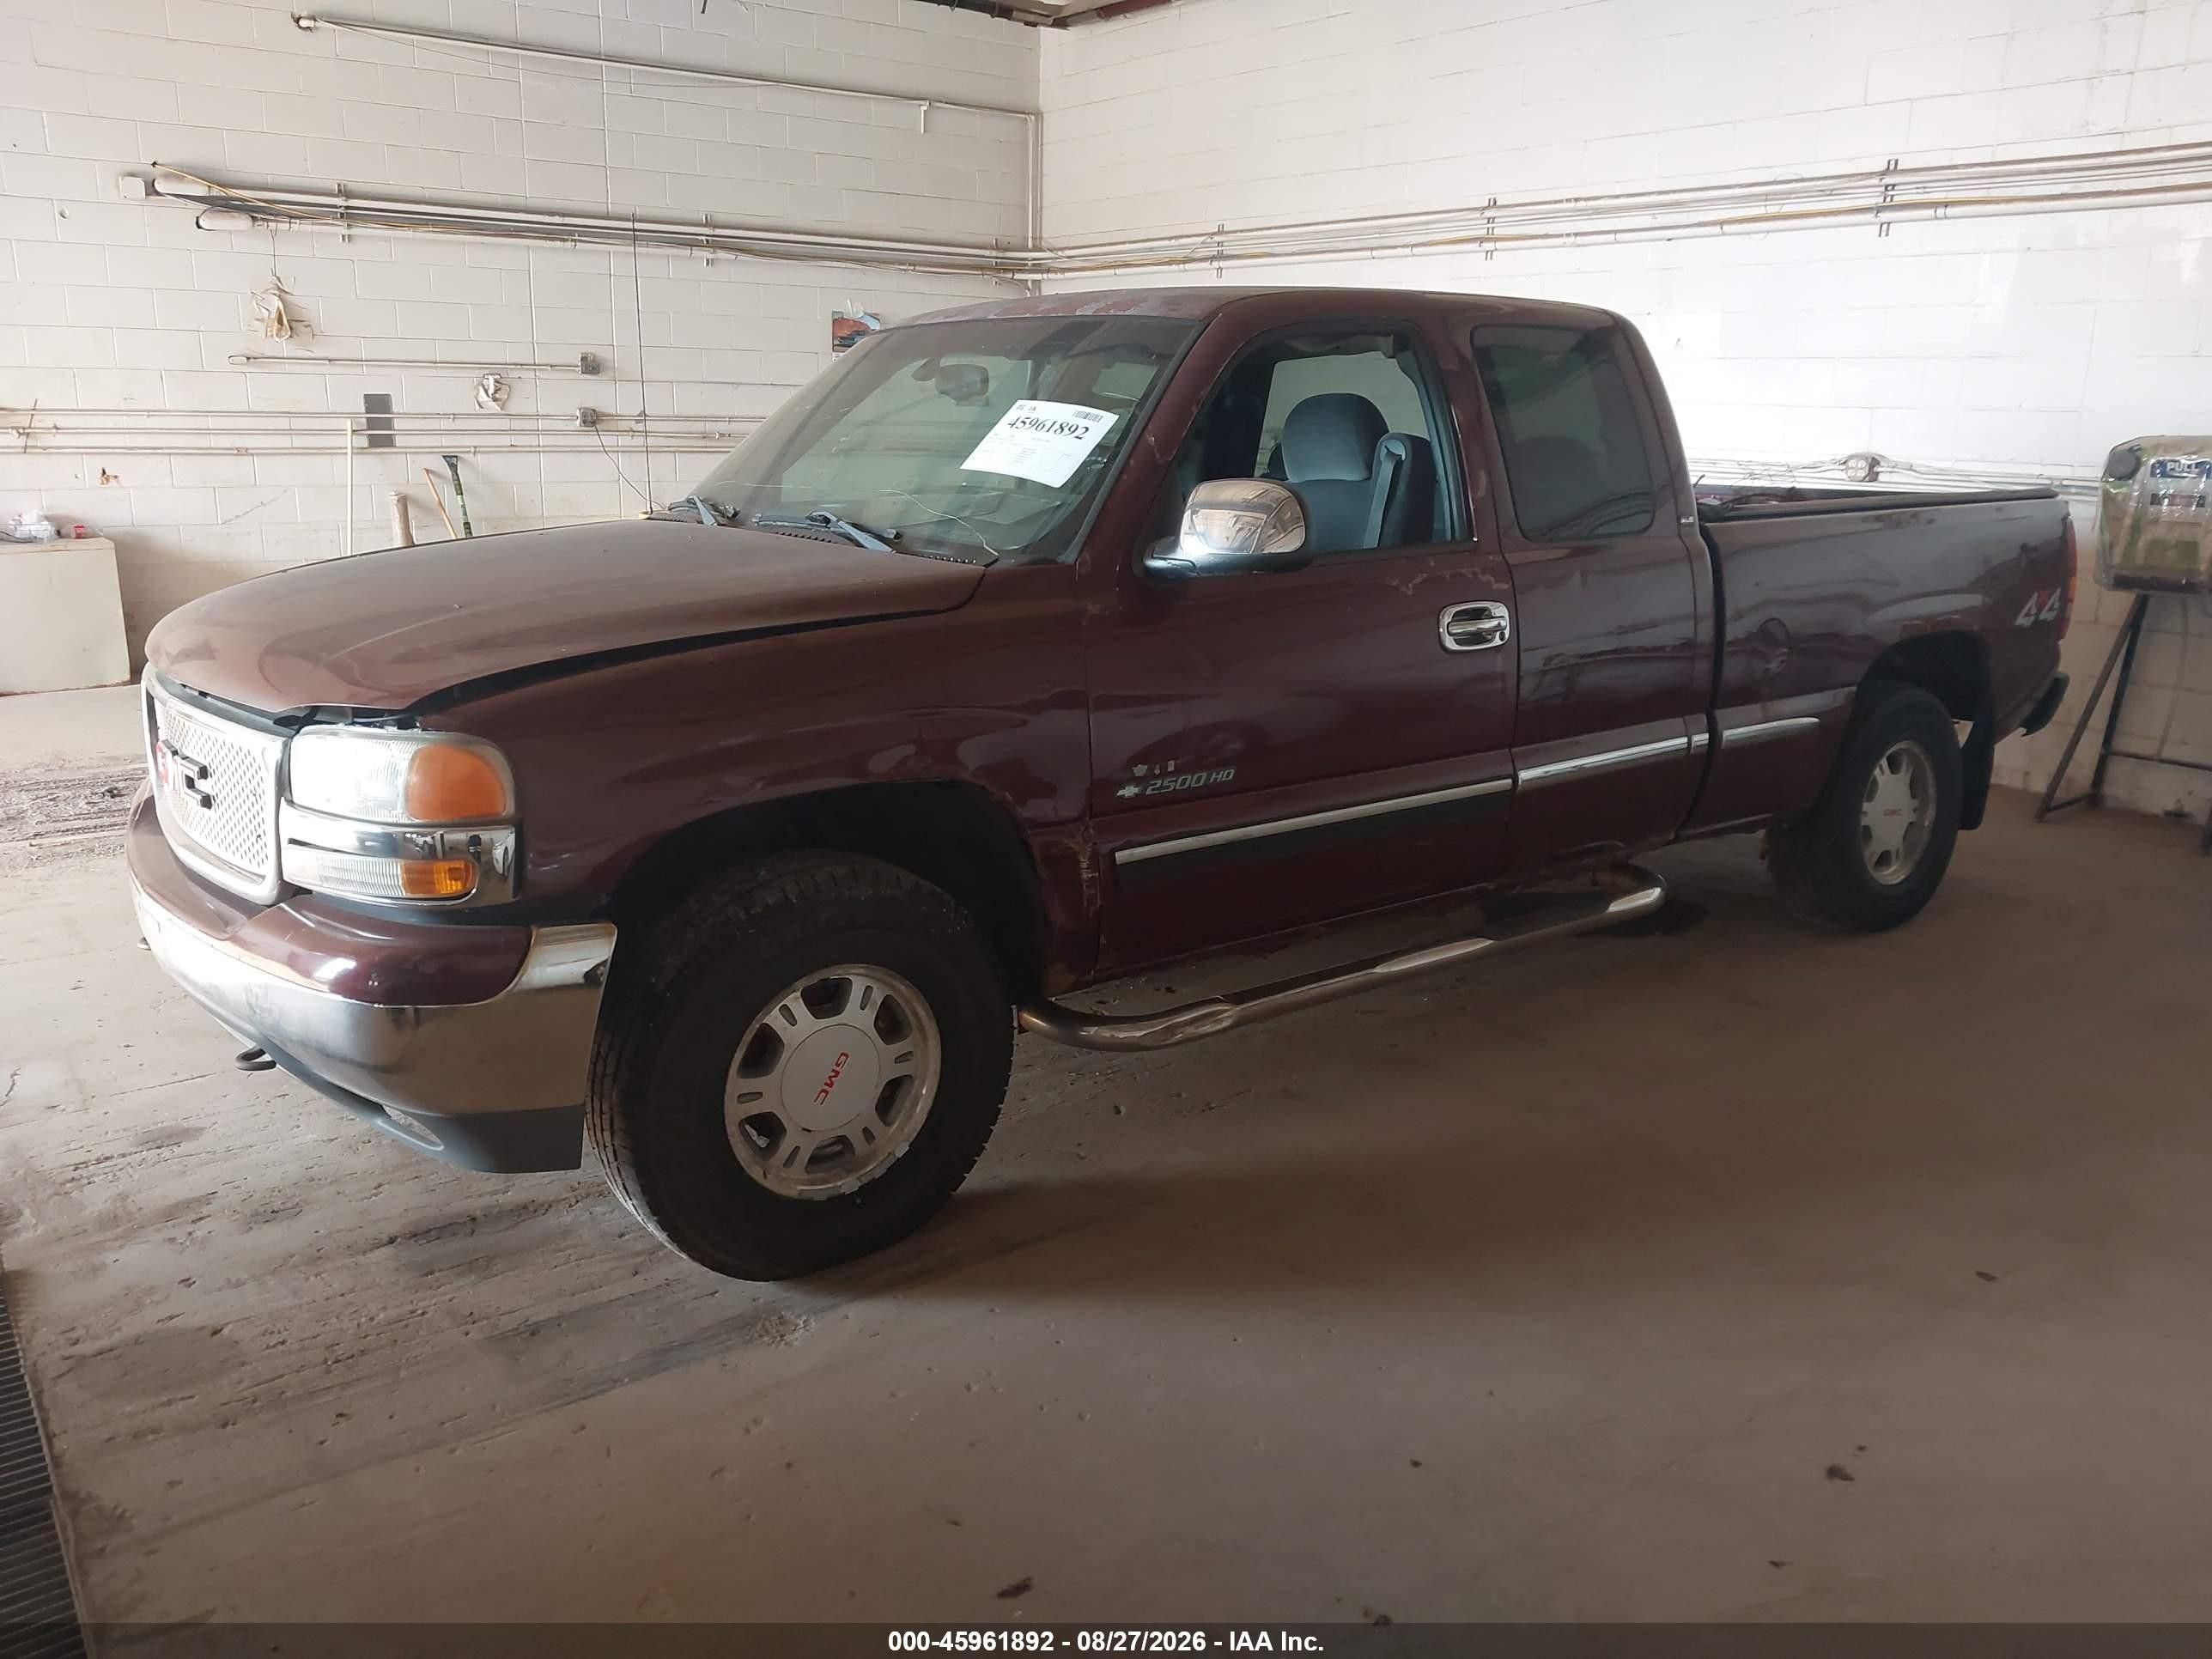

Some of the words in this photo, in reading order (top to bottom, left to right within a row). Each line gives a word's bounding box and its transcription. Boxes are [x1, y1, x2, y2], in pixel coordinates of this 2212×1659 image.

[1007, 416, 1091, 441] 45961892
[1146, 772, 1207, 796] 2500
[1209, 769, 1236, 784] HD
[813, 1051, 850, 1106] GMC
